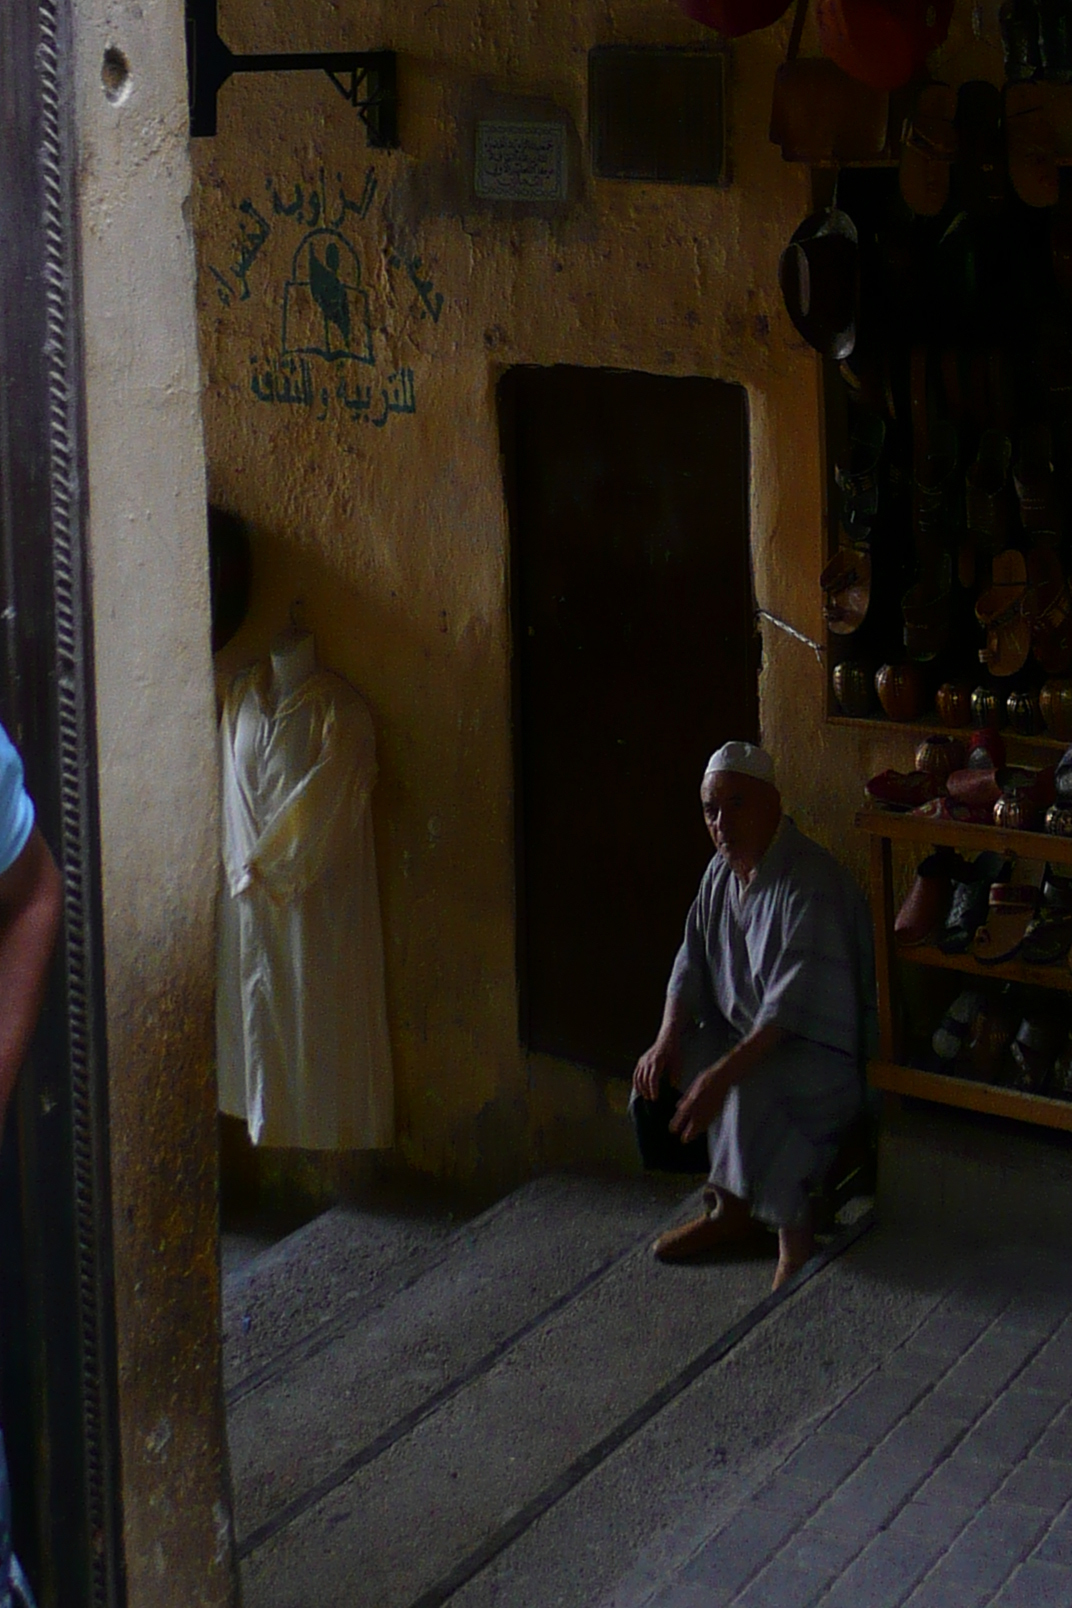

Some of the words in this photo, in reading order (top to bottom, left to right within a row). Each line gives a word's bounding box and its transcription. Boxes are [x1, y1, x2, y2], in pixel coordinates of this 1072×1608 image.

[266, 165, 378, 229] الزاوية
[208, 197, 270, 307] الخضراء
[336, 360, 416, 427] للتربية
